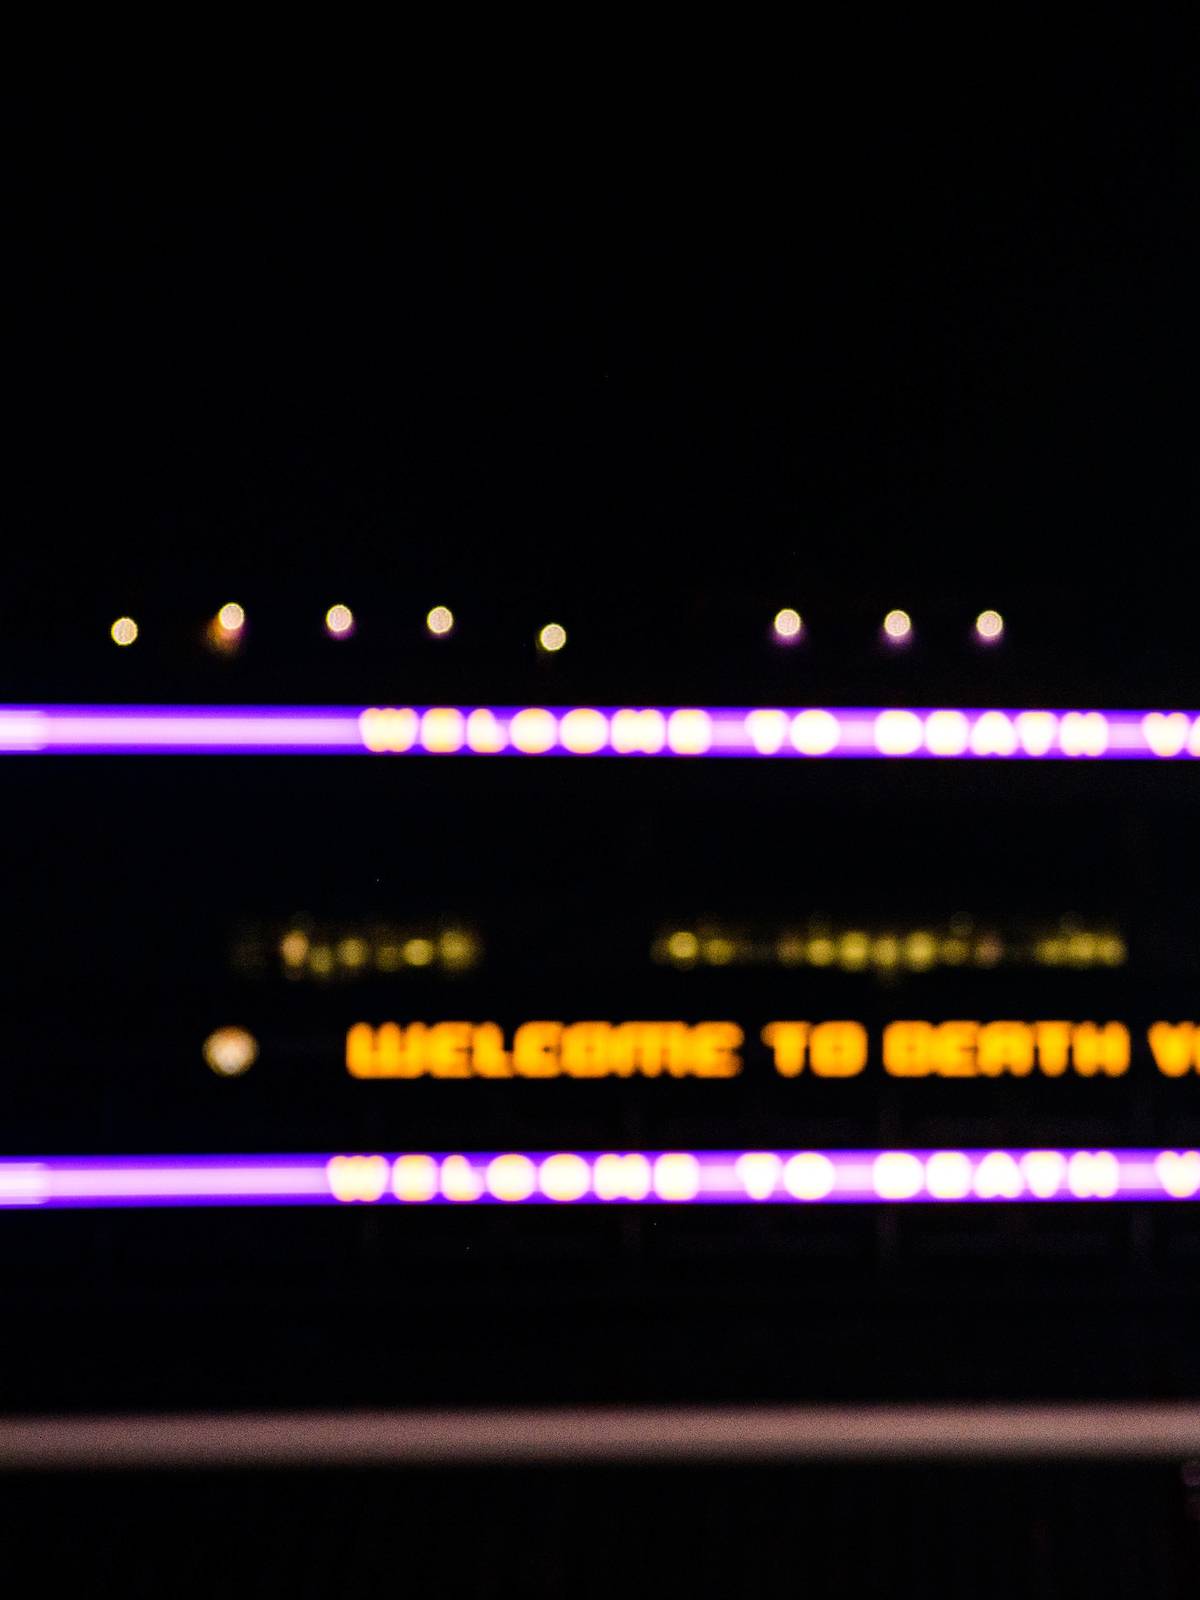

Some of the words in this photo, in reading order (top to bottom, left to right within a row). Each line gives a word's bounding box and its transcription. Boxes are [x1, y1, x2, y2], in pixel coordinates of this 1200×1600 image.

[346, 1020, 744, 1078] WELCOME
[761, 1020, 868, 1077] TO
[882, 1020, 1131, 1077] DEATH
